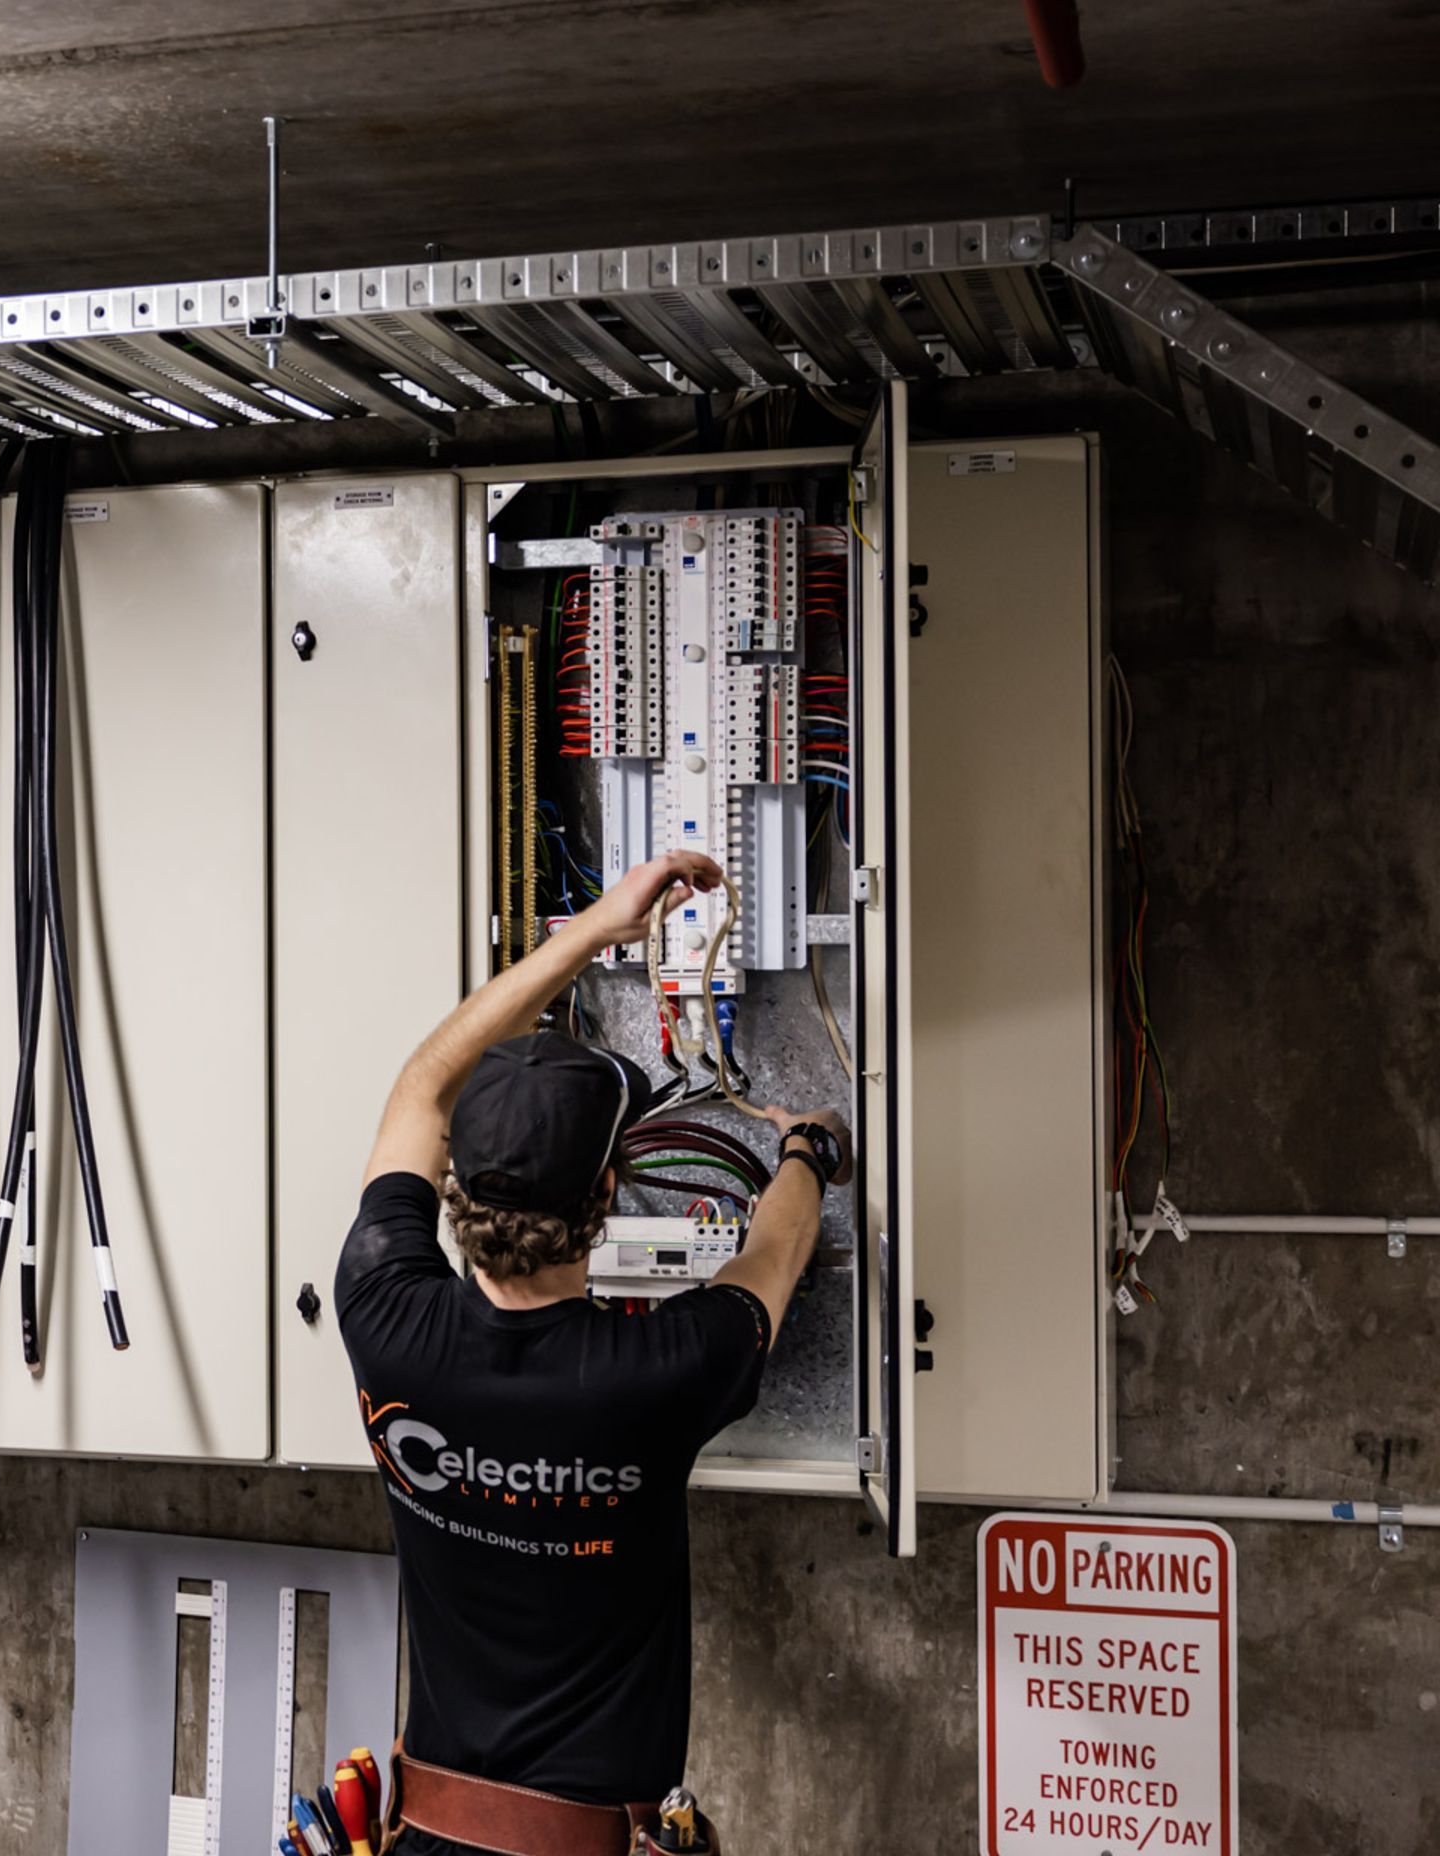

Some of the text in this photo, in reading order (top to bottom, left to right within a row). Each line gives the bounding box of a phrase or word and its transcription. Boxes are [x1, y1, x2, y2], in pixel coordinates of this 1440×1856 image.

[460, 1484, 619, 1508] LIMITED
[449, 1521, 539, 1555] BUILDINGS
[544, 1541, 569, 1557] TO
[573, 1540, 614, 1557] LIFE
[998, 1538, 1212, 1595] NO PARKING
[1014, 1633, 1201, 1674] THIS SPACE
[1026, 1678, 1190, 1717] RESERVED
[1060, 1738, 1157, 1770] TOWING
[1040, 1774, 1178, 1807] ENFORCED
[1004, 1807, 1212, 1850] 24 HOURS/DAY
